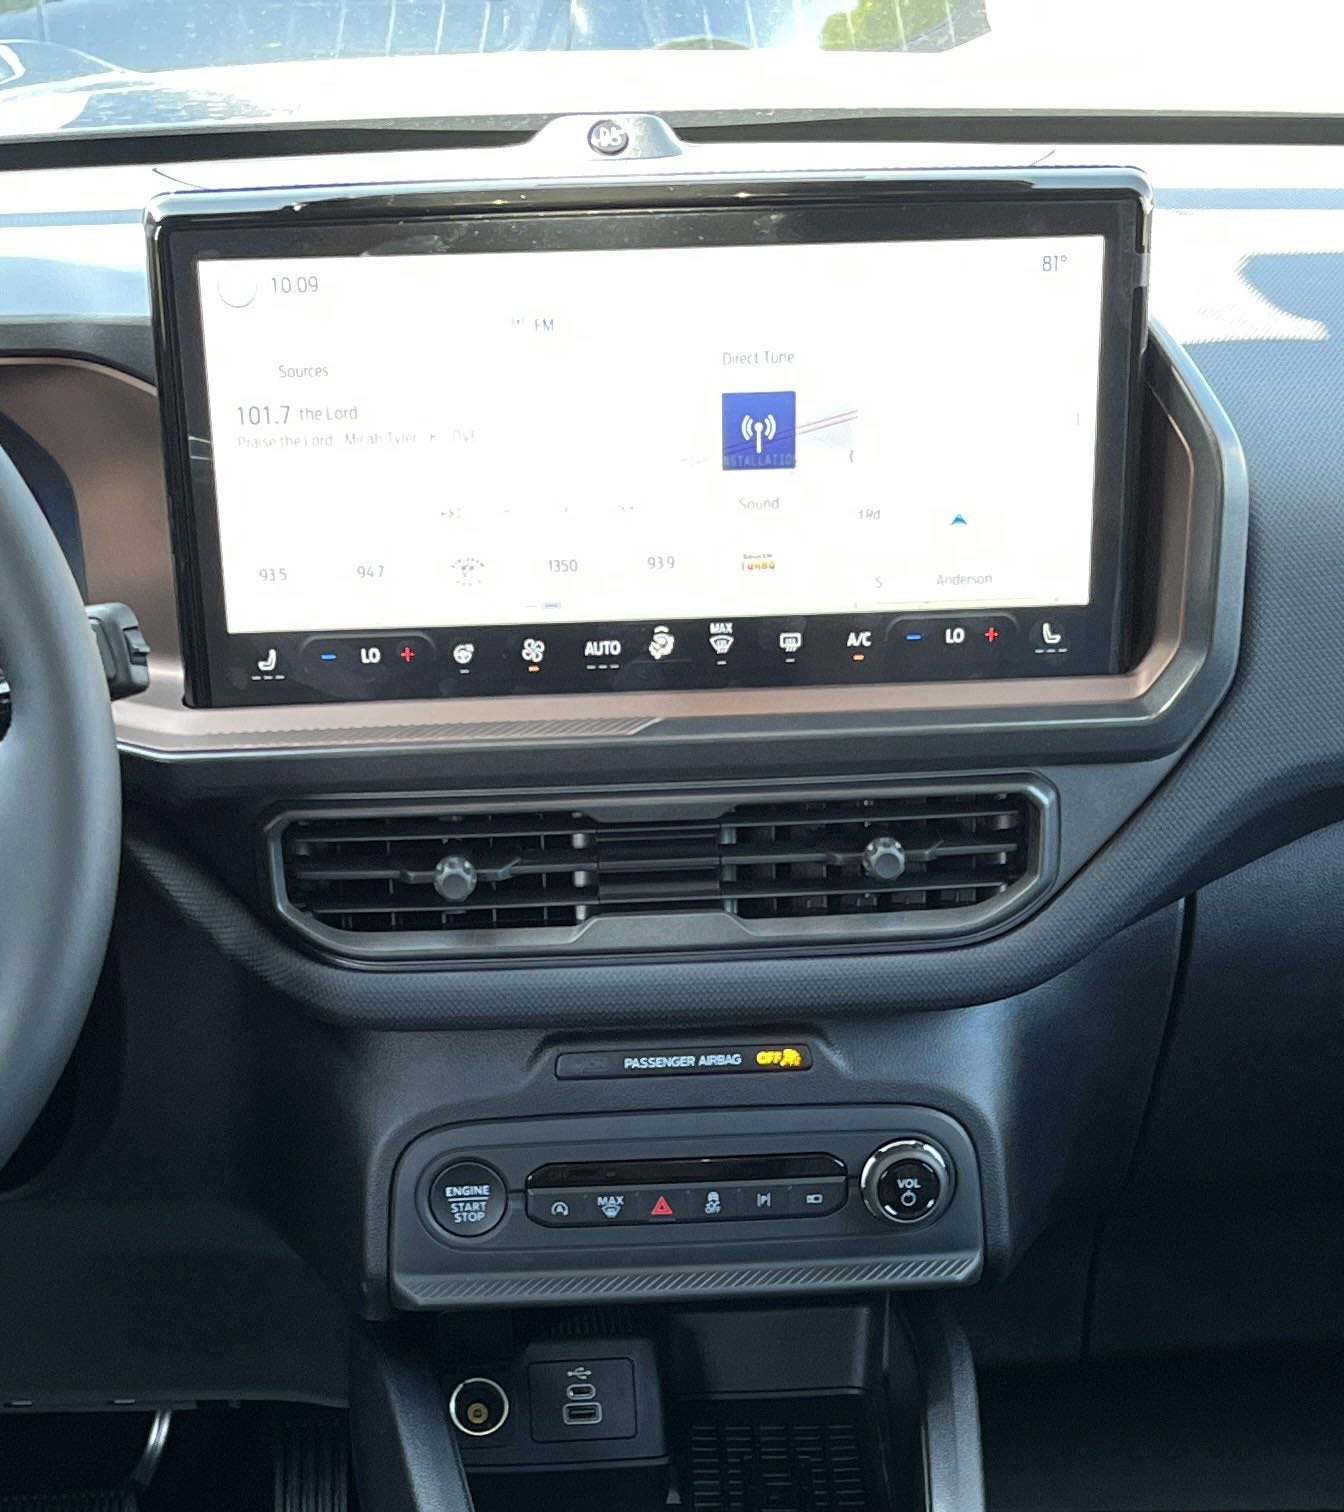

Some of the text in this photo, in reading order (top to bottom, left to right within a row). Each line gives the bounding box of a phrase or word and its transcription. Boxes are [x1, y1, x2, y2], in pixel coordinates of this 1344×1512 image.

[721, 350, 795, 366] Direct Tune
[278, 363, 329, 379] Sources
[237, 404, 359, 425] 101.7 the Lord
[548, 558, 579, 573] 1350
[937, 572, 993, 585] Anderson
[710, 623, 734, 634] MAX
[945, 628, 965, 643] LO
[846, 632, 872, 648] A/C
[361, 648, 381, 663] LO
[585, 640, 621, 656] AUTO
[624, 1051, 782, 1069] PASSENGER AIRBAG OFF
[897, 1178, 921, 1188] VOL
[445, 1185, 490, 1197] ENGINE
[450, 1201, 487, 1213] START
[597, 1196, 624, 1206] MAX
[454, 1211, 485, 1223] STOP
[705, 1206, 721, 1214] OFF
